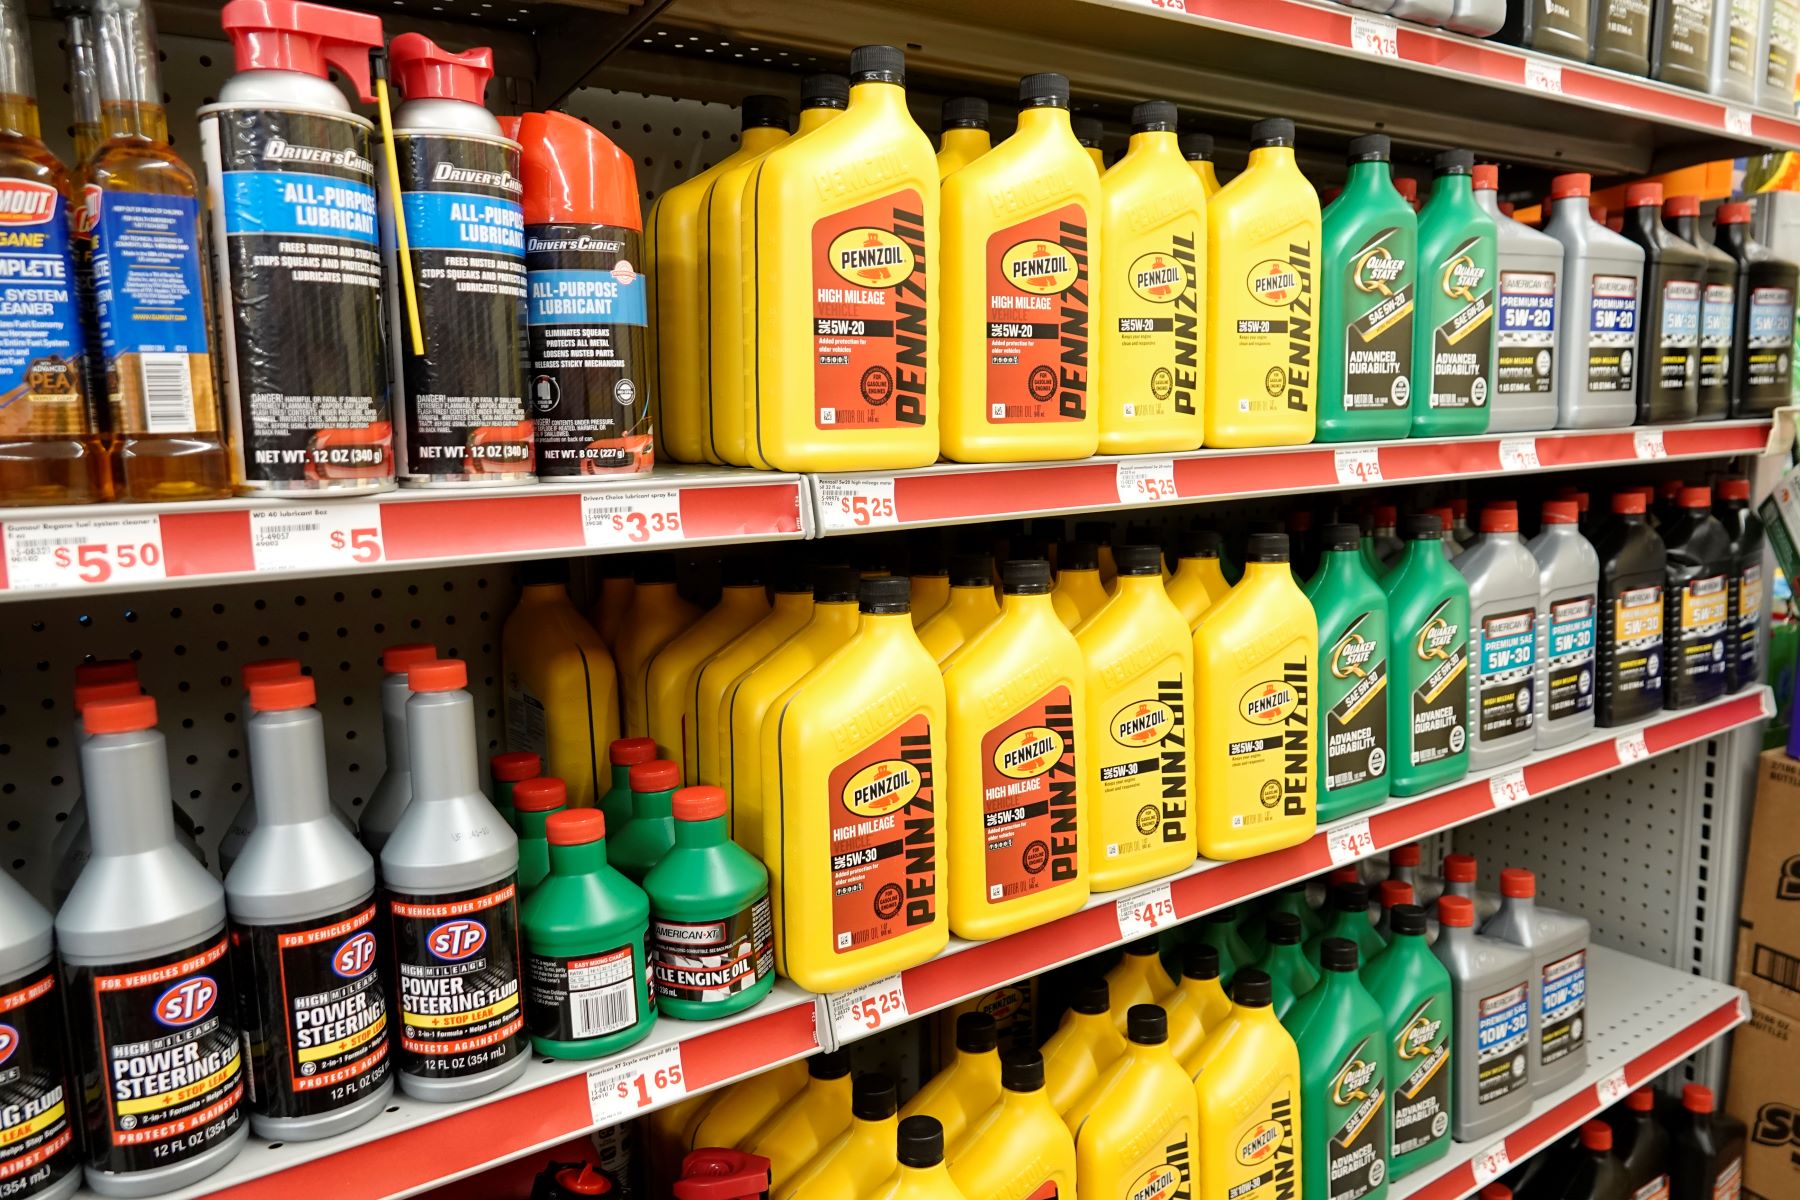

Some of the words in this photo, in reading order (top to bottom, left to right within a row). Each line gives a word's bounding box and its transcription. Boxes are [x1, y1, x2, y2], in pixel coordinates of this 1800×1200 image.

[295, 204, 374, 235] LUBRICANT
[280, 242, 306, 256] FREES
[307, 244, 339, 258] RUSTED
[841, 246, 904, 270] PENNZOIL
[253, 255, 280, 267] STOPS
[281, 256, 320, 270] SQUEAKS
[1013, 256, 1068, 278] PENNZOIL
[1366, 256, 1405, 271] QUAKER
[292, 270, 342, 284] LUBRICATES
[1137, 268, 1180, 289] PENNZOIL
[1255, 273, 1295, 292] PENNZOIL
[1370, 269, 1399, 281] STATE
[5, 289, 69, 303] SYSTEM
[533, 281, 619, 299] ALL-PURPOSE
[817, 289, 842, 303] HIGH
[844, 289, 886, 305] MILEAGE
[540, 298, 613, 316] LUBRICANT
[991, 295, 1014, 310] HIGH
[1015, 297, 1052, 311] MILEAGE
[1501, 297, 1538, 308] PREMIUM
[818, 319, 831, 335] SAE
[831, 320, 865, 336] 5W-20
[1130, 319, 1154, 331] 5W-20
[1248, 321, 1270, 332] 5W-20
[1505, 309, 1551, 328] 5W-20
[1595, 311, 1634, 328] 5W-20
[545, 329, 581, 337] ELIMINATES
[582, 329, 610, 338] SQUEAKS
[1003, 324, 1033, 338] 5W-20
[543, 350, 570, 358] LOOSENS
[1349, 351, 1396, 363] ADVANCED
[1436, 353, 1477, 364] ADVANCED
[560, 360, 583, 368] STICKY
[584, 360, 625, 368] MECHANISMS
[1348, 362, 1401, 375] DURABILITY
[32, 373, 66, 390] PEA
[255, 449, 280, 464] NET
[281, 448, 310, 464] WT.
[312, 449, 328, 463] 12
[330, 449, 350, 463] OZ
[350, 448, 373, 463] (340
[373, 449, 383, 464] g)
[545, 450, 560, 459] NET
[561, 450, 578, 458] WT.
[579, 450, 586, 458] 8
[586, 449, 599, 458] OZ
[599, 449, 616, 459] (227
[1342, 640, 1377, 658] QUAKER
[1485, 640, 1518, 655] PREMIUM
[1555, 632, 1592, 653] 5W-30
[1345, 652, 1372, 666] STATE
[1488, 648, 1531, 670] 5W-30
[1248, 690, 1291, 716] PENNZOIL
[1120, 710, 1166, 738] PENNZOIL
[1415, 706, 1453, 724] ADVANCED
[1329, 727, 1371, 747] ADVANCED
[1004, 737, 1055, 769] PENNZOIL
[1240, 740, 1264, 754] 5W-30
[1328, 737, 1377, 758] DURABILITY
[1113, 763, 1138, 779] 5W-30
[854, 770, 910, 807] PENNZOIL
[986, 785, 1007, 801] HIGH
[1007, 778, 1041, 798] MILEAGE
[997, 807, 1025, 825] 5W-30
[833, 825, 857, 844] HIGH
[858, 815, 895, 837] MILEAGE
[846, 848, 878, 868] 5W-30
[408, 905, 448, 917] VEHICLES
[451, 903, 475, 914] OVER
[477, 898, 493, 909] 75K
[495, 888, 514, 902] MILES
[435, 923, 481, 956] STP
[655, 926, 703, 940] AMERICAN
[342, 937, 374, 973] STP
[574, 960, 589, 969] EASY
[400, 963, 424, 977] HIGH
[425, 959, 487, 978] MILEAGE
[677, 968, 731, 987] ENGINE
[731, 958, 751, 979] OIL
[401, 976, 464, 996] POWER
[165, 981, 213, 1021] STP
[403, 989, 486, 1015] STEERING
[489, 979, 518, 1004] FLUID
[1544, 981, 1585, 1011] 10W-30
[296, 991, 367, 1030] POWER
[443, 1015, 469, 1026] STOP
[471, 1007, 494, 1022] LEAK
[405, 1040, 449, 1054] PROTECTS
[454, 1033, 499, 1051] AGAINST
[502, 1019, 522, 1037] WEAR
[1480, 1014, 1528, 1045] 10W-30
[113, 1041, 199, 1081] POWER
[424, 1060, 435, 1070] 12
[438, 1059, 450, 1070] FL
[451, 1056, 466, 1069] OZ
[467, 1052, 489, 1068] (354
[490, 1044, 507, 1060] mL)
[116, 1049, 220, 1101] STEERING
[1241, 1126, 1276, 1160] PENNZOIL
[1331, 1143, 1373, 1171] ADVANCED
